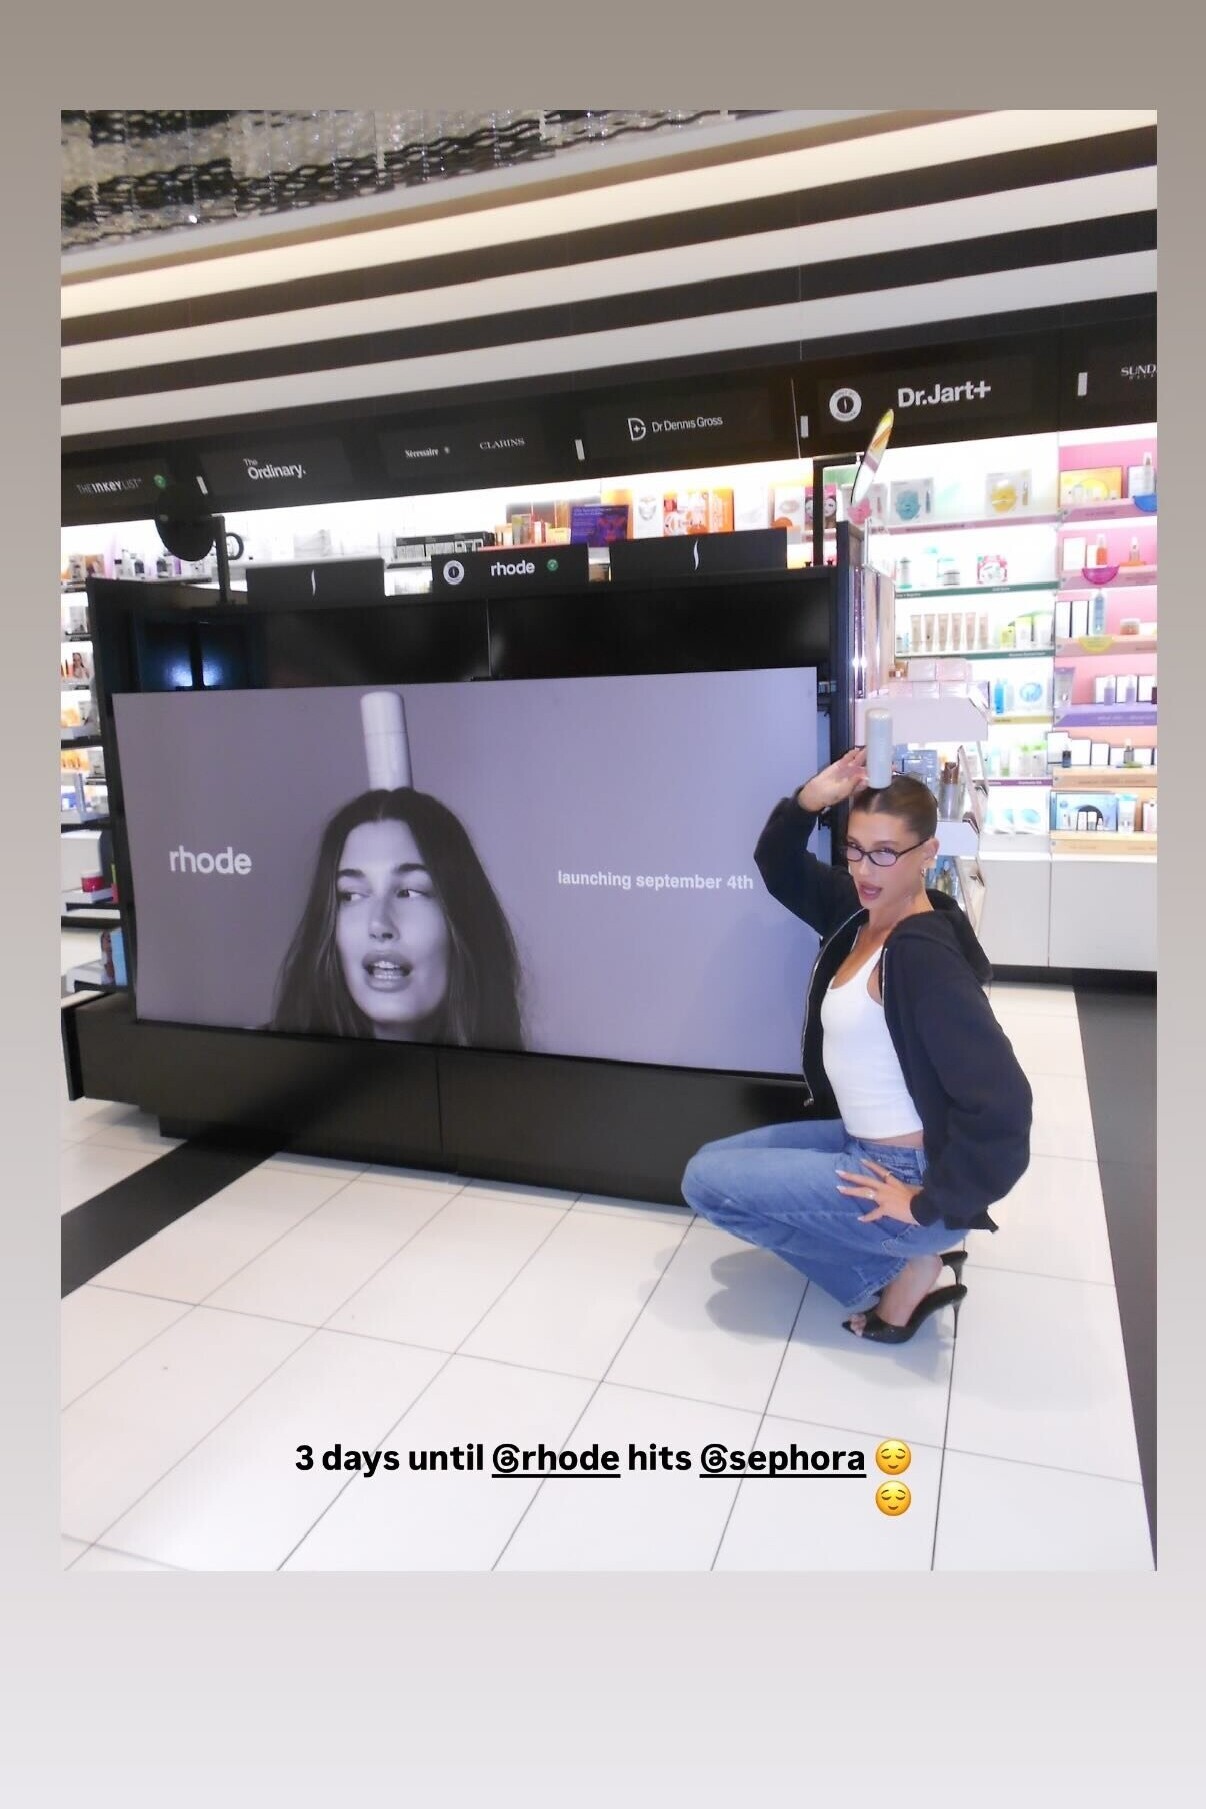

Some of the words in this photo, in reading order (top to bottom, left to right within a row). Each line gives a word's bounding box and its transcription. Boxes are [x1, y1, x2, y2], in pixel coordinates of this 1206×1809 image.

[898, 380, 991, 408] Dr.Jart+
[652, 421, 663, 432] Dr
[664, 419, 696, 431] Dennis
[697, 416, 723, 428] Gross
[480, 438, 525, 450] CLARINS
[243, 458, 258, 466] The
[247, 464, 306, 479] Ordinary.
[491, 560, 535, 576] rhode
[169, 845, 252, 875] rhode
[558, 870, 632, 890] launching
[636, 874, 722, 891] september
[727, 875, 754, 889] 4th
